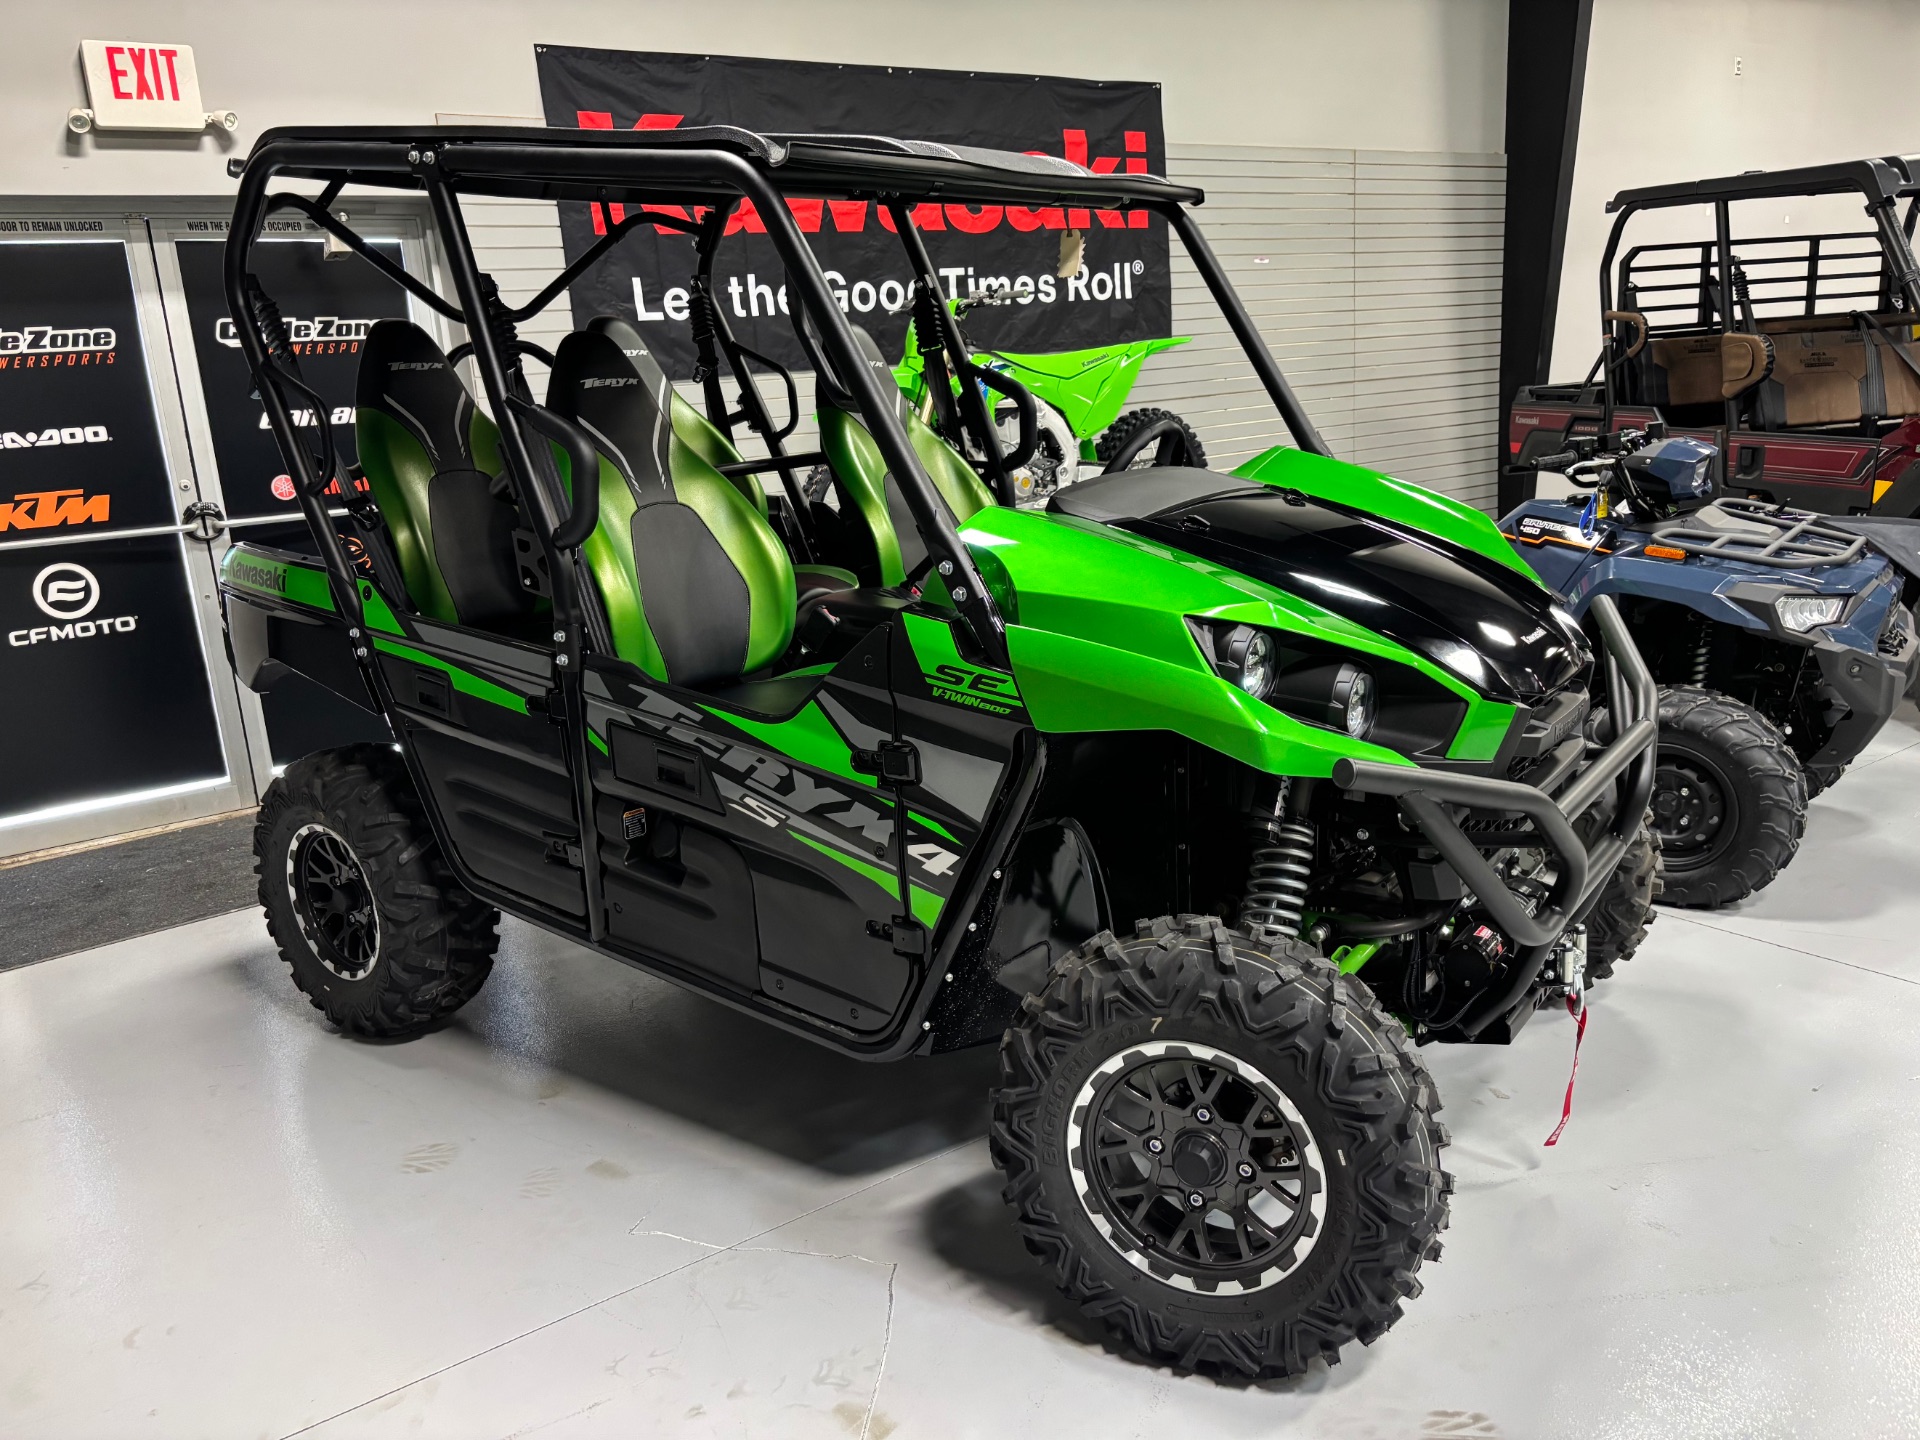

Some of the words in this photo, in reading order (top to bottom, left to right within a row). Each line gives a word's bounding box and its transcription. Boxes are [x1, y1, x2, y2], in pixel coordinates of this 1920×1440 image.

[105, 46, 180, 101] EXIT
[0, 221, 18, 232] OOR
[19, 221, 30, 232] TO
[32, 221, 62, 232] REMAIN
[64, 221, 104, 232] UNLOCKED
[187, 221, 209, 231] WHEN
[210, 221, 224, 231] THE
[268, 221, 302, 231] OCCUPIED
[631, 277, 691, 322] Le
[823, 270, 916, 313] Goo
[938, 266, 1056, 306] Times
[1081, 351, 1110, 368] Kawasaki
[580, 376, 639, 389] TERYX
[1515, 416, 1539, 425] Kawasaki
[0, 488, 111, 532] KTM
[1520, 525, 1541, 535] 450
[229, 556, 288, 593] Kawasaki
[8, 616, 137, 647] CFMOTO
[928, 664, 1020, 699] SE
